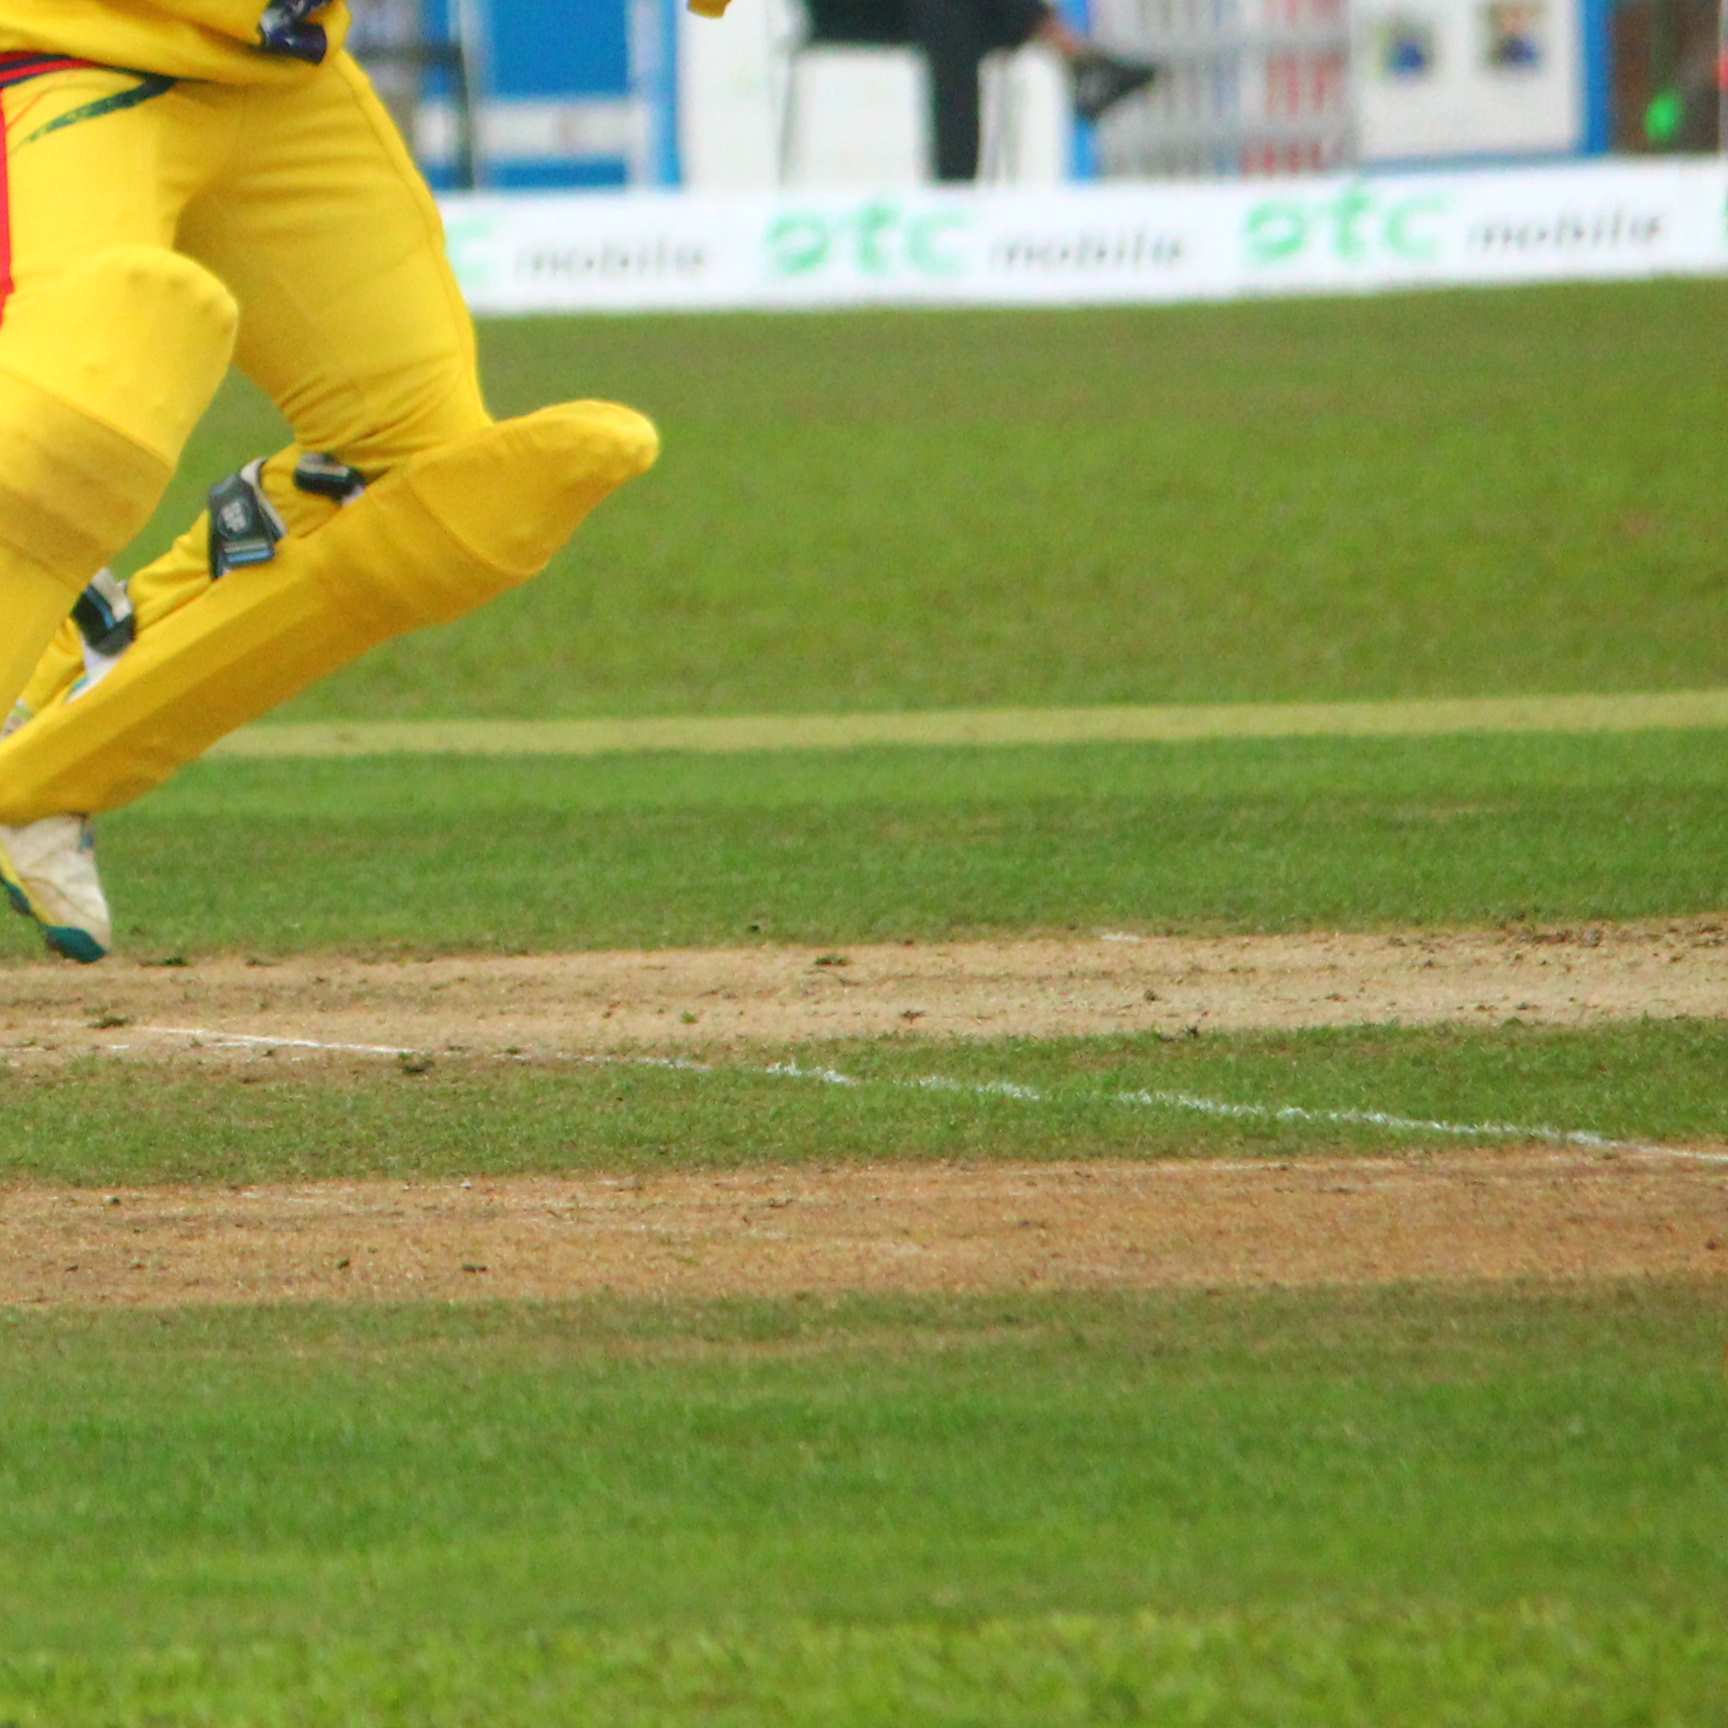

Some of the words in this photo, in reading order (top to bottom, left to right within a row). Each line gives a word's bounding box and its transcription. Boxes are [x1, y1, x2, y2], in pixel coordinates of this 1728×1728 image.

[1465, 210, 1664, 252] mobile
[517, 236, 705, 275] mobile
[992, 232, 1186, 270] mobile
